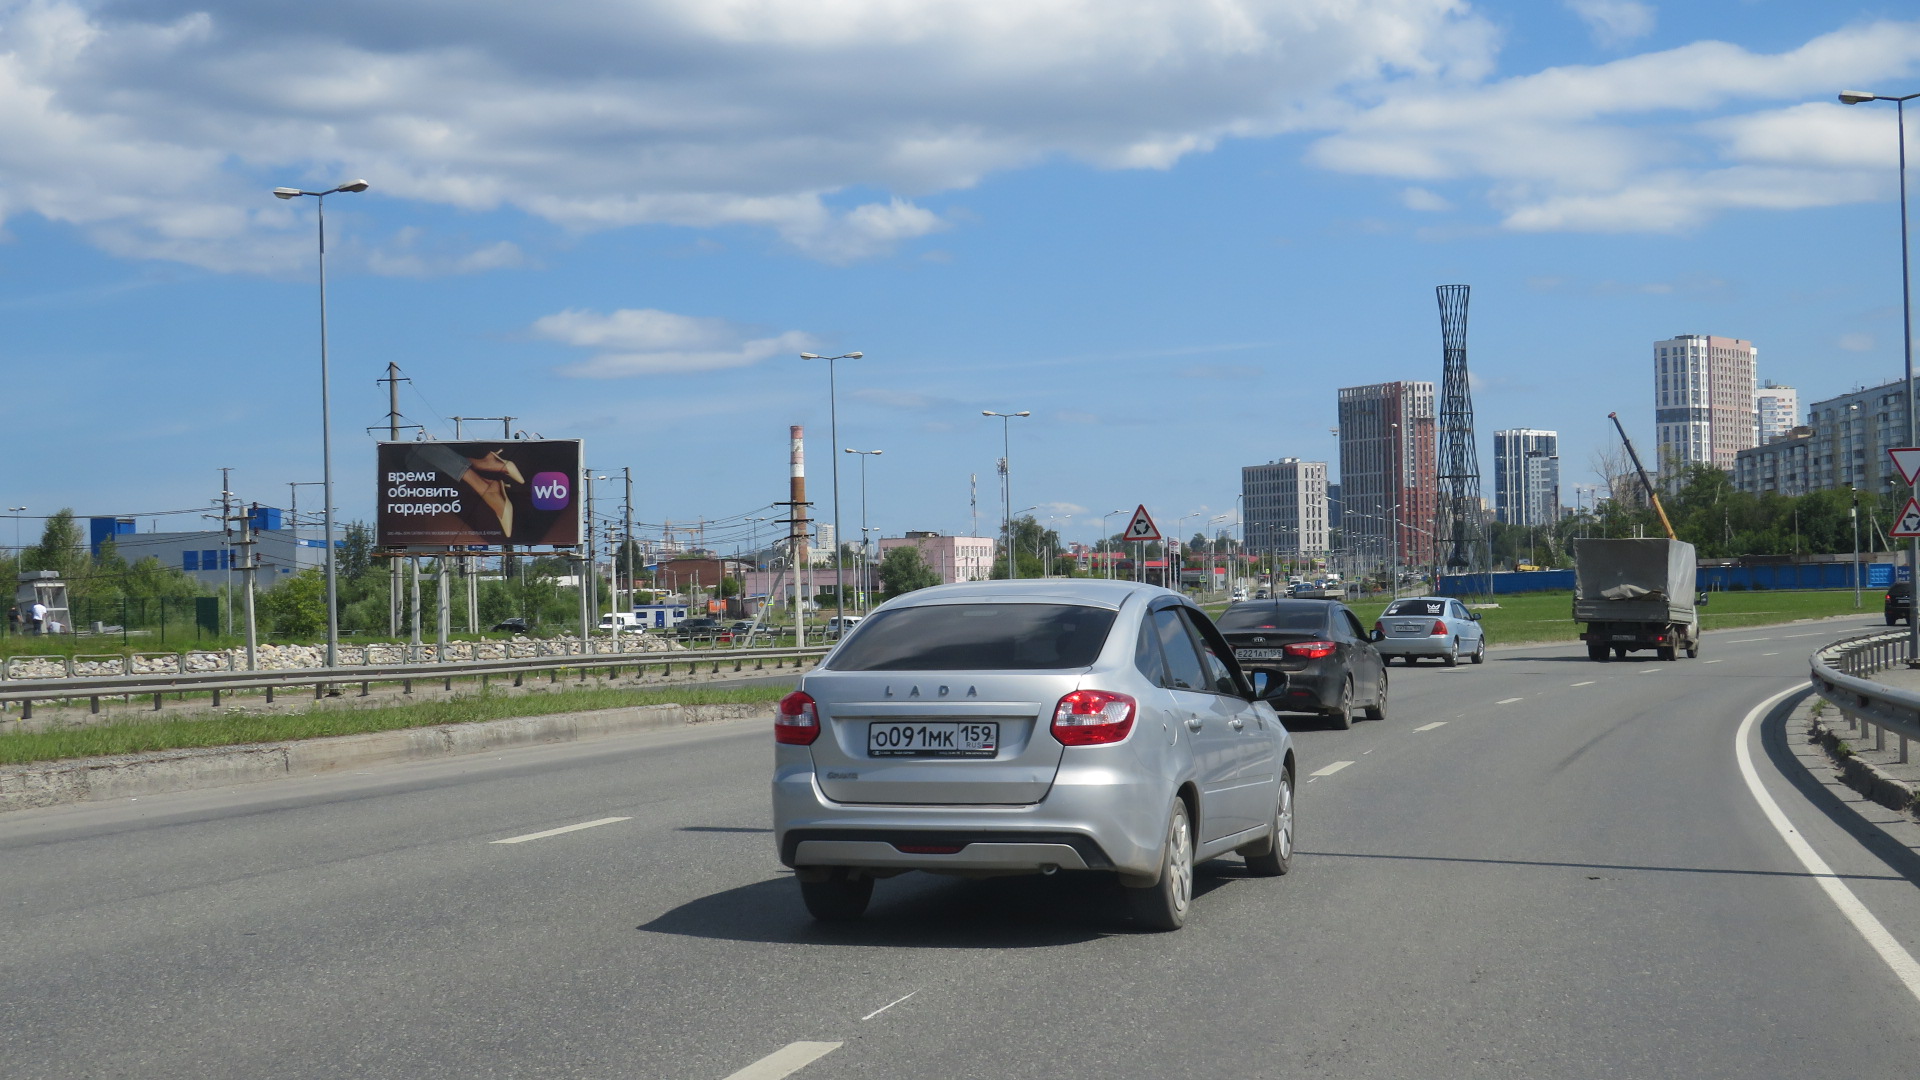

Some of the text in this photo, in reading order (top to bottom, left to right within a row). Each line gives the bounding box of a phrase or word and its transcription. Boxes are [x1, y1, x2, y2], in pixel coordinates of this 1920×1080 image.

[388, 472, 436, 484] время
[387, 484, 459, 498] обновить
[534, 479, 567, 499] wb
[387, 500, 462, 516] гардероб
[885, 685, 978, 698] LADA
[960, 725, 992, 742] 159
